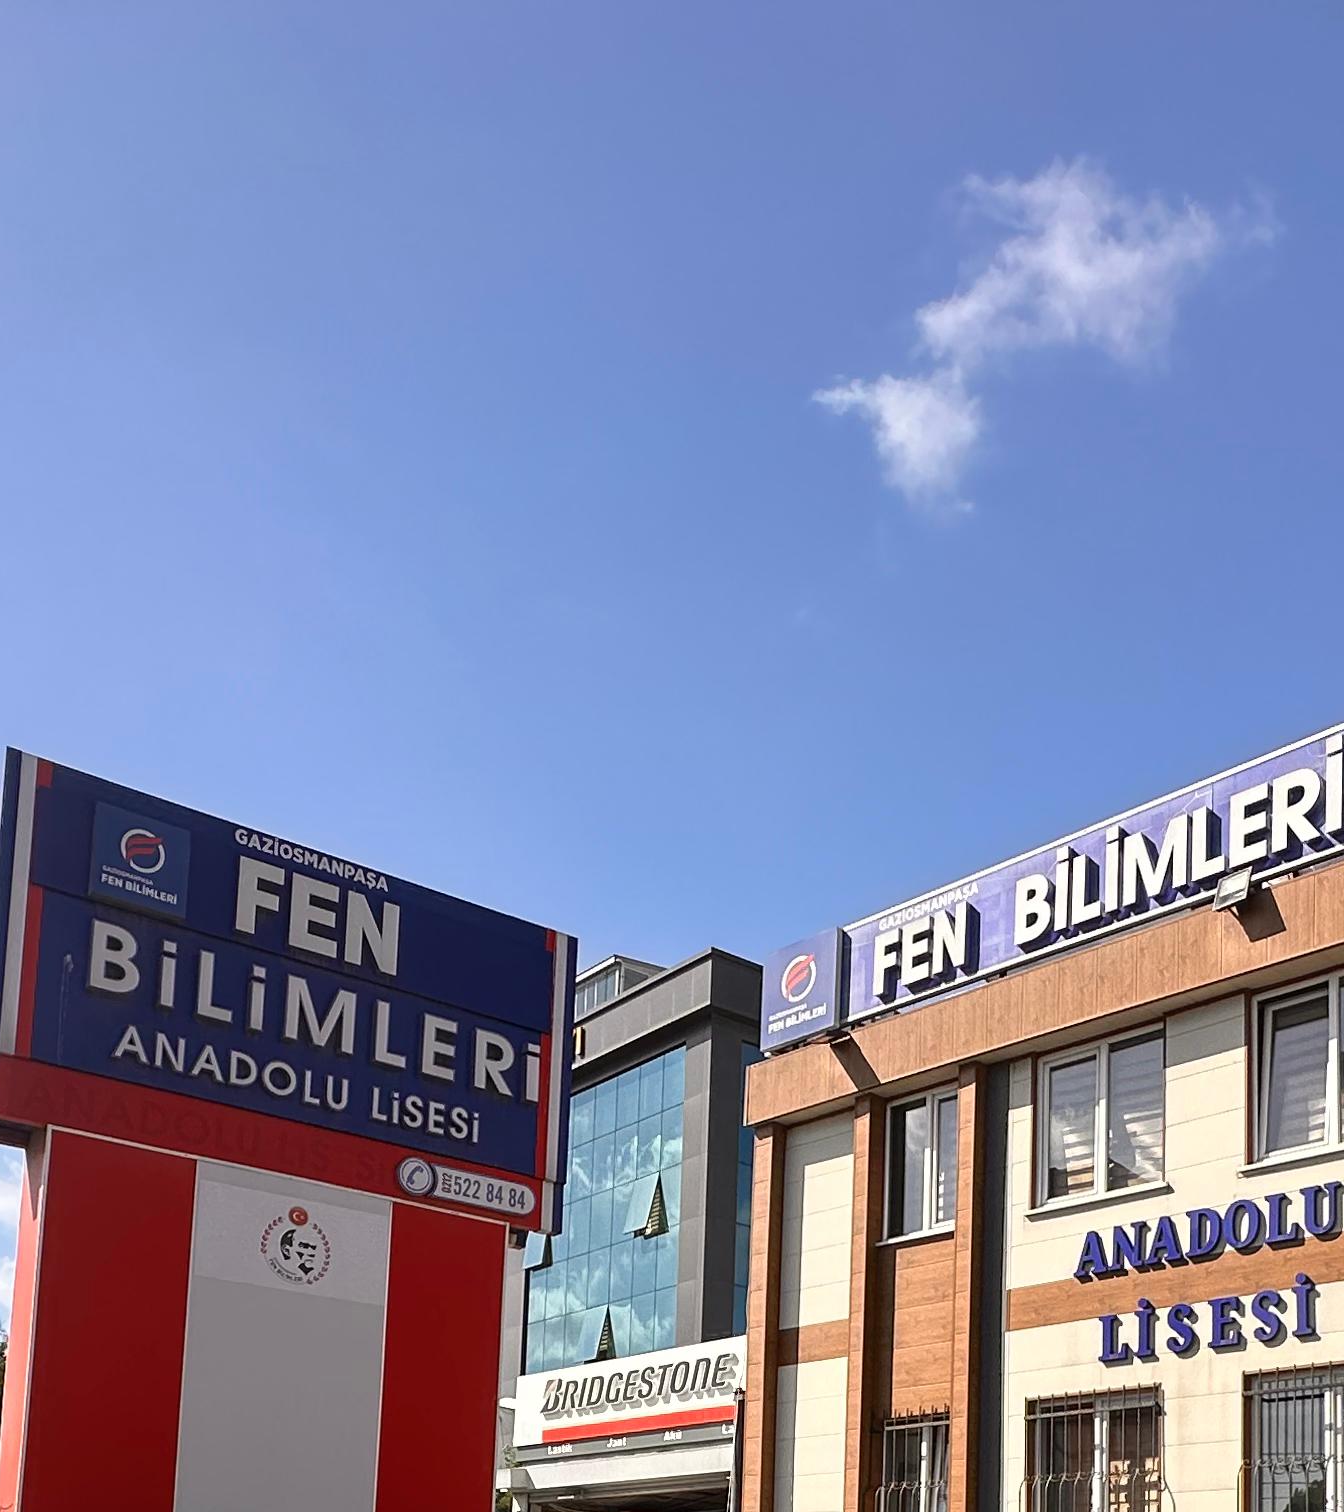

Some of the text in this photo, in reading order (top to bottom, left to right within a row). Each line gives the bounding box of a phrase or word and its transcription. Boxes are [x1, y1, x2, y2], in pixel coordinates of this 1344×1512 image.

[101, 873, 178, 905] FEN BİLİMLERİ
[234, 828, 389, 893] GAZİOSMANPAŞA
[878, 881, 979, 931] GAZİOSMANPAŞA
[233, 855, 401, 977] FEN
[872, 900, 970, 997] FEN
[85, 918, 543, 1104] BİLİMLERİ
[112, 1024, 481, 1145] ANADOLU LİSESİ
[453, 1175, 481, 1200] 522
[485, 1183, 504, 1205] 84
[508, 1187, 526, 1210] 84
[1073, 1181, 1344, 1279] ANADOLU
[1098, 1272, 1318, 1363] LİSESİ
[540, 1353, 732, 1414] BRIDGESTONE
